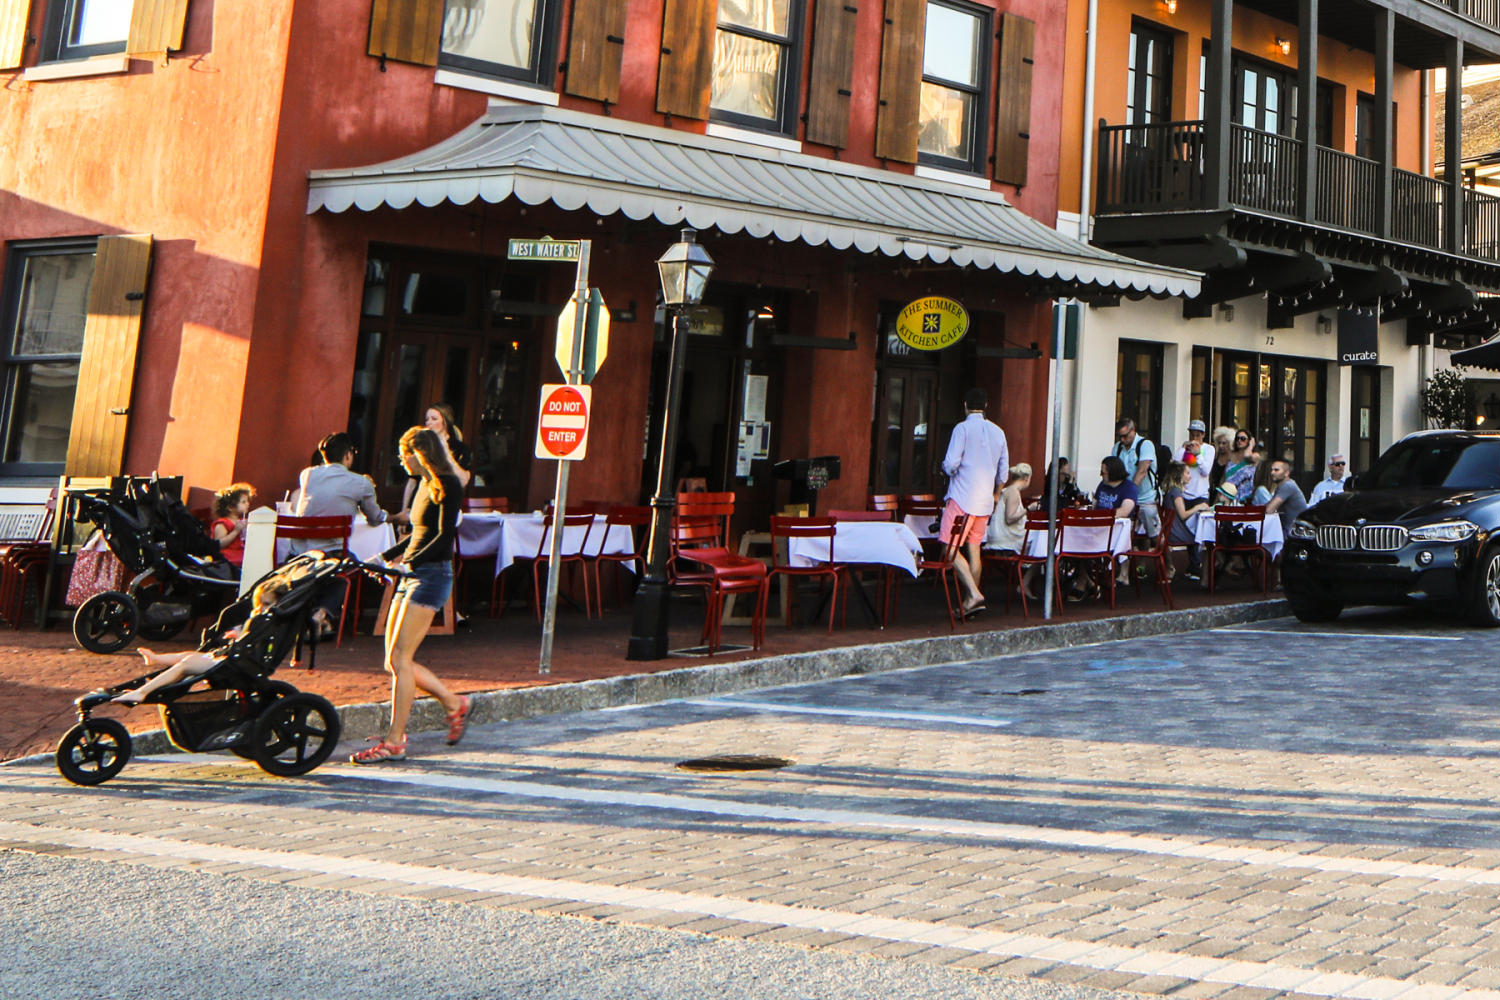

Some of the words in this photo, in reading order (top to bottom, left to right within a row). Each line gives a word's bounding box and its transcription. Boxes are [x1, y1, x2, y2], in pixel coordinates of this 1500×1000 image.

[511, 241, 534, 257] WEST
[536, 242, 566, 258] WATER
[903, 303, 922, 318] THE
[923, 300, 963, 319] SUMMER
[899, 324, 938, 346] KITCHEN
[1342, 351, 1377, 362] curate
[549, 401, 562, 412] DO
[563, 402, 582, 412] NOT
[548, 431, 577, 442] ENTER
